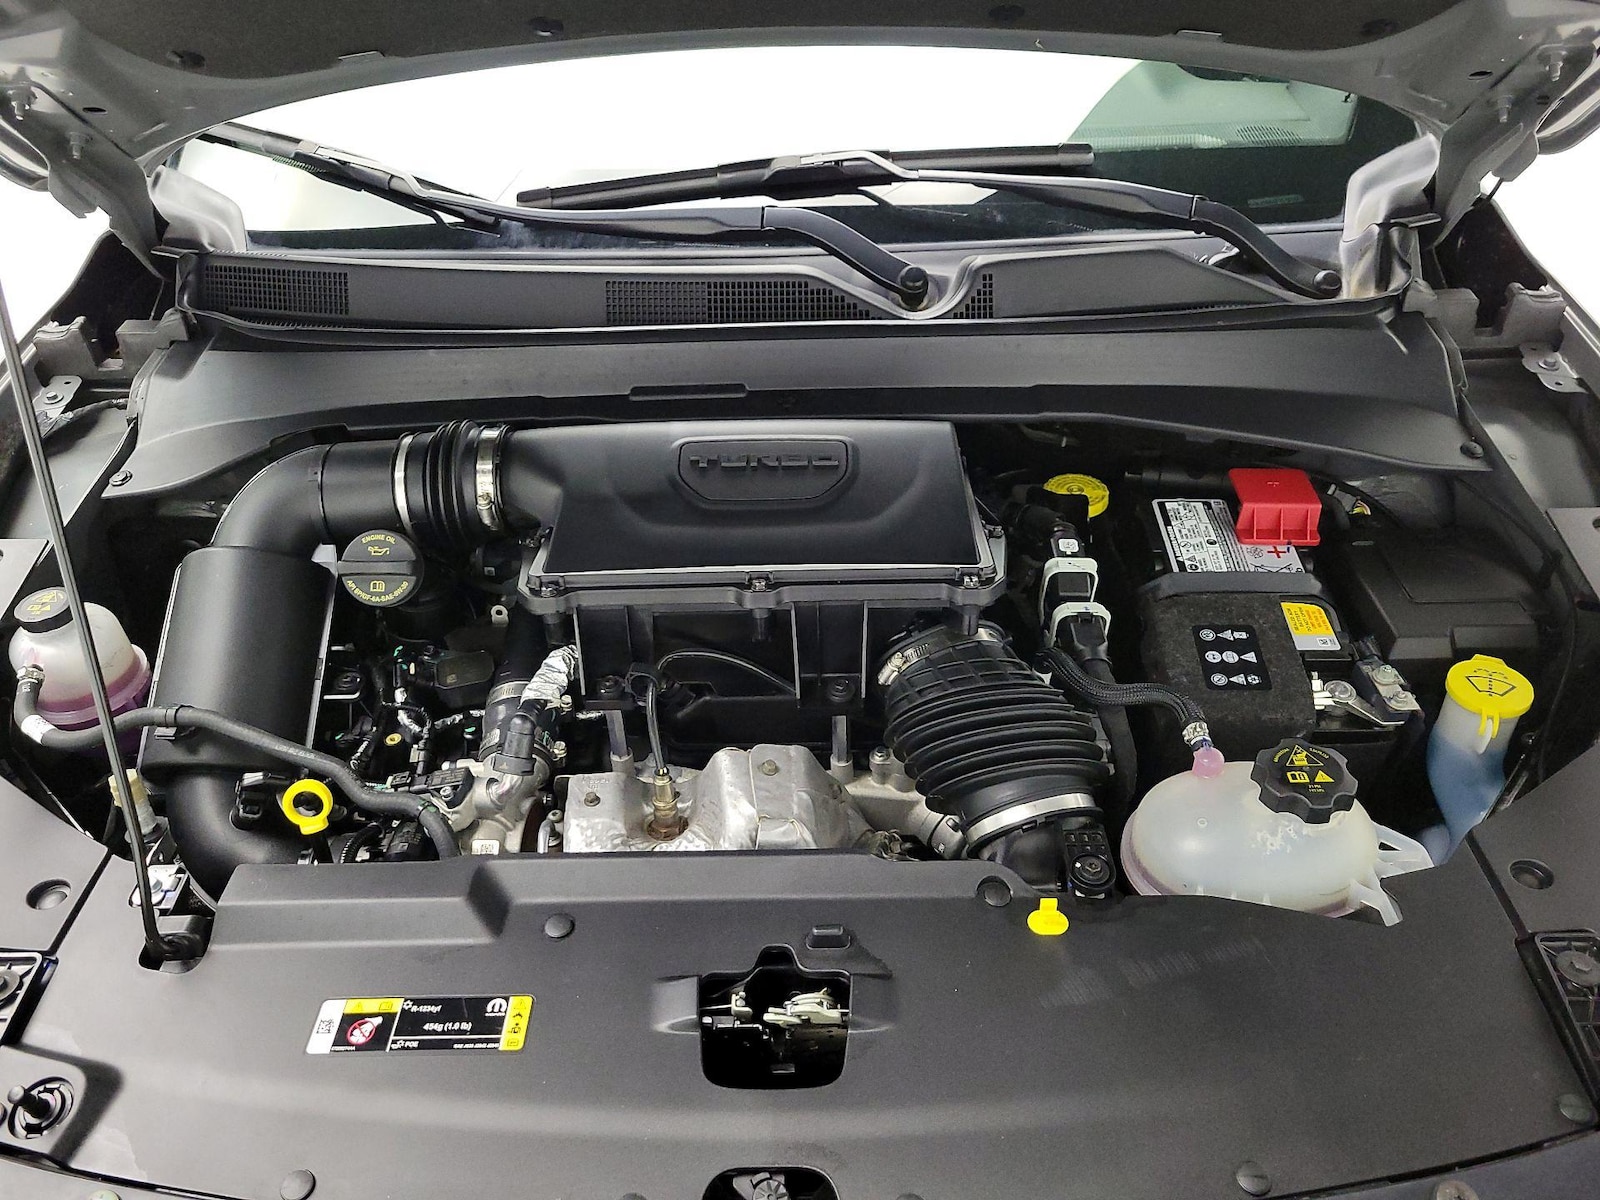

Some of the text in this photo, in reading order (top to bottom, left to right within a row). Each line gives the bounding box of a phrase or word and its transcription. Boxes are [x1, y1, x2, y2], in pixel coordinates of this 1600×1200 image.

[690, 455, 840, 468] TURBO
[361, 534, 396, 544] ENGINE OIL
[346, 580, 357, 590] API
[423, 1022, 443, 1031] 454g
[460, 1022, 472, 1031] lb)
